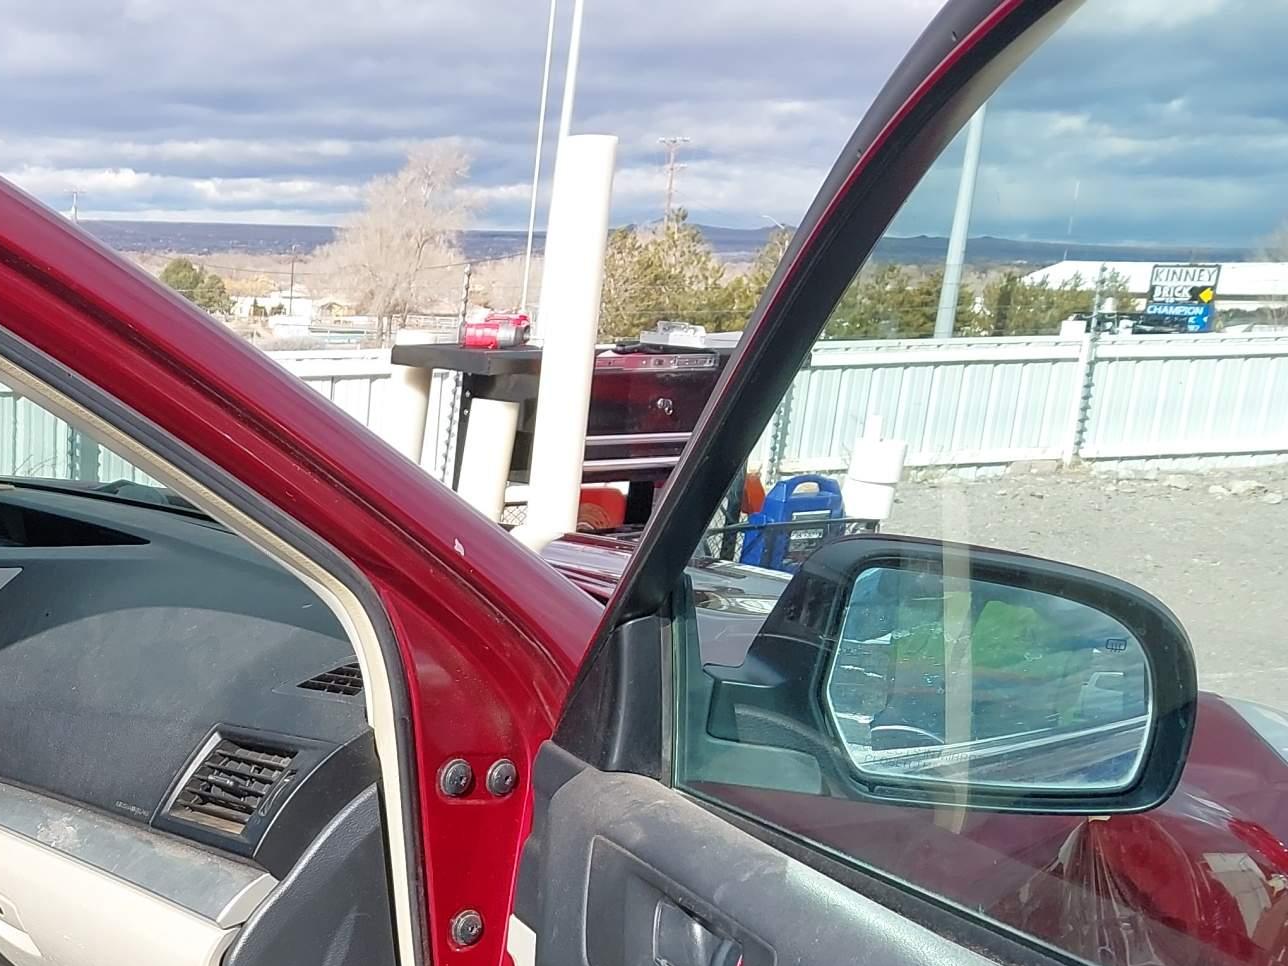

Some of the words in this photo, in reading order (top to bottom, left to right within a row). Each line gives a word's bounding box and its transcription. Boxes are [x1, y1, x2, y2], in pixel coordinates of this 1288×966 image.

[1155, 268, 1217, 281] KINNEY
[1153, 286, 1192, 298] BRICK
[1146, 305, 1204, 315] CHAMPION
